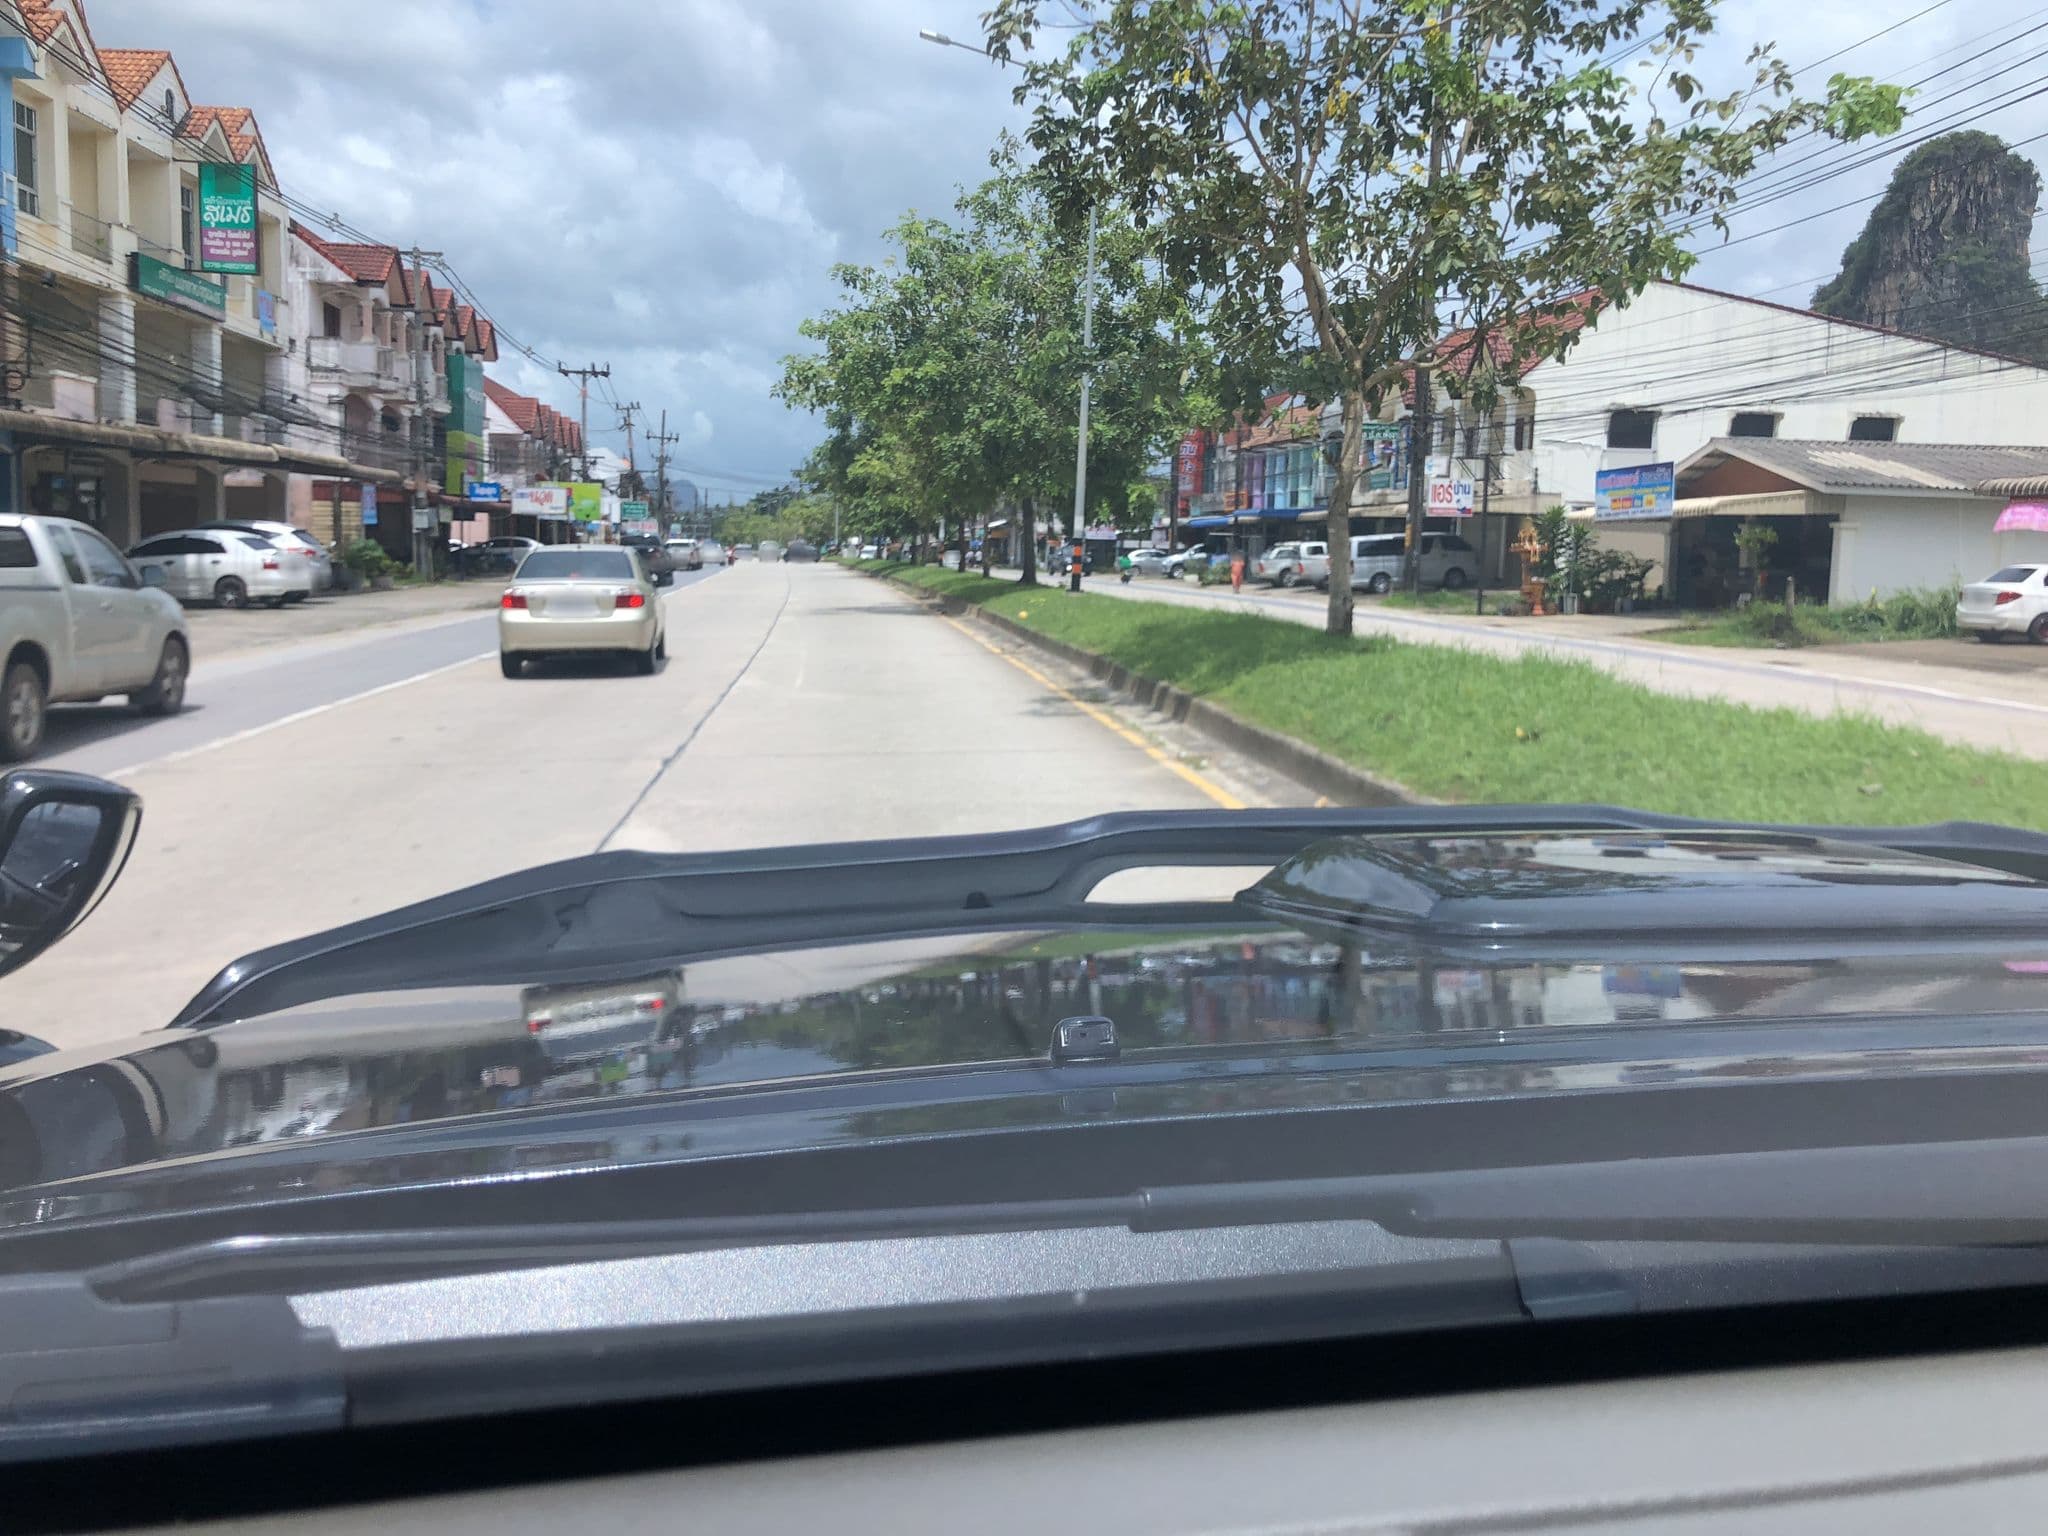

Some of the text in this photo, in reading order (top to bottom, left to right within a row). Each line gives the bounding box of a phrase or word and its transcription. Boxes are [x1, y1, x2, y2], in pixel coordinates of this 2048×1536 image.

[203, 204, 253, 228] สุเมธ
[1431, 480, 1471, 504] แอร์ บ้าน
